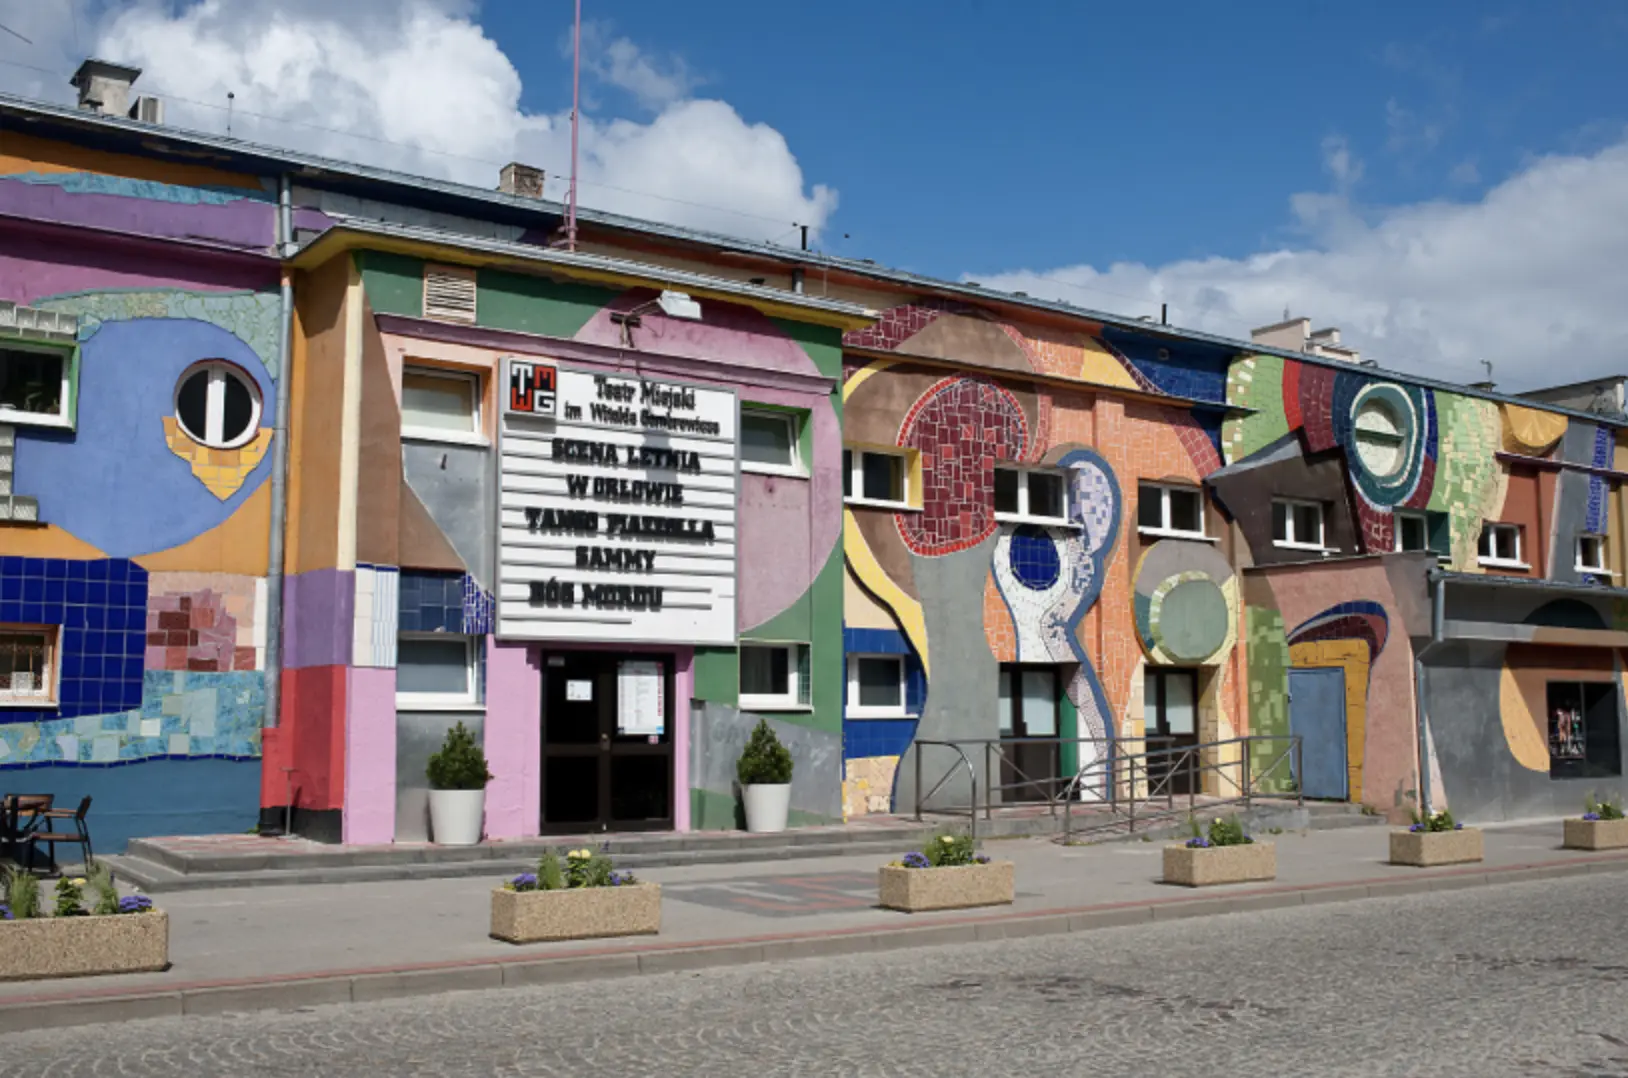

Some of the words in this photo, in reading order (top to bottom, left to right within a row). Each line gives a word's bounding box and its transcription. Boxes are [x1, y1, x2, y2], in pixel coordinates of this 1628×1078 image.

[594, 374, 636, 402] Teatr
[640, 378, 695, 413] Miejski
[552, 438, 618, 467] SCENA
[627, 446, 700, 474] LETNIA
[566, 474, 588, 499] W
[525, 507, 598, 536] TANGO
[606, 513, 714, 543] PIAZZOLLA
[576, 546, 656, 573] SAMMY
[581, 583, 664, 612] MORDU
